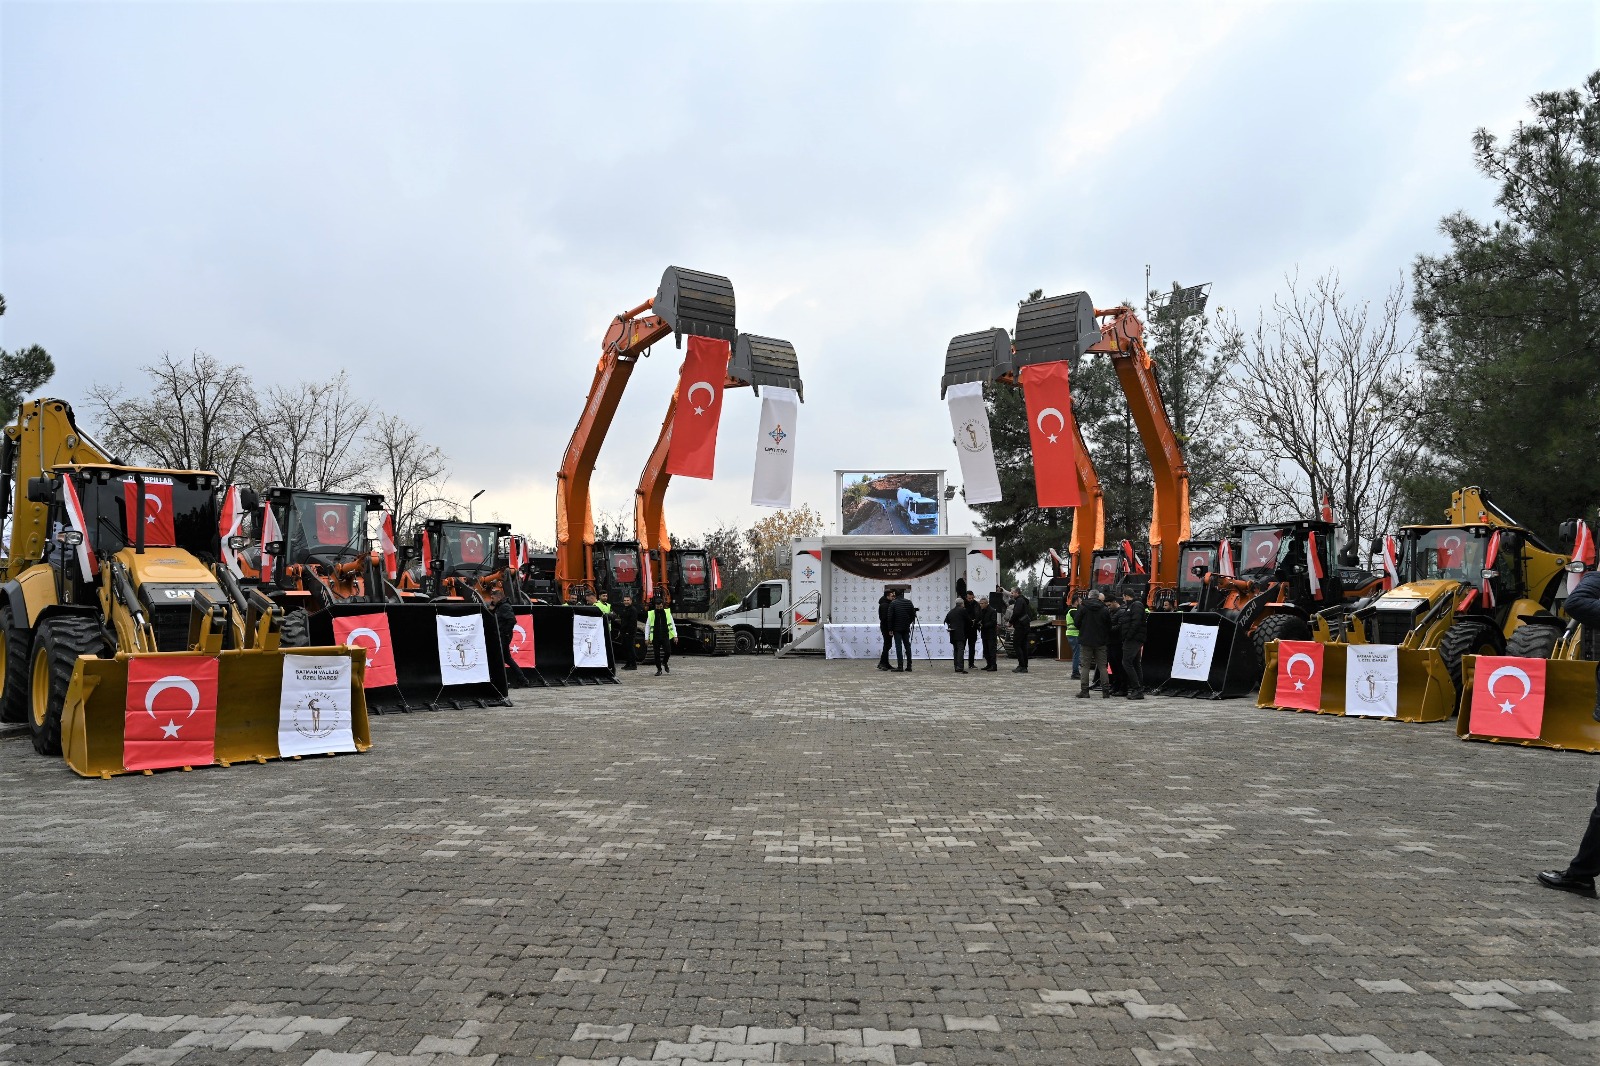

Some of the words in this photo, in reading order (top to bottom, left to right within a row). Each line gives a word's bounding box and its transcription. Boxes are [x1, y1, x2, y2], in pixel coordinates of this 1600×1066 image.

[128, 475, 173, 484] CRPILLAR
[166, 588, 196, 600] CAT
[1239, 600, 1257, 626] TACHI
